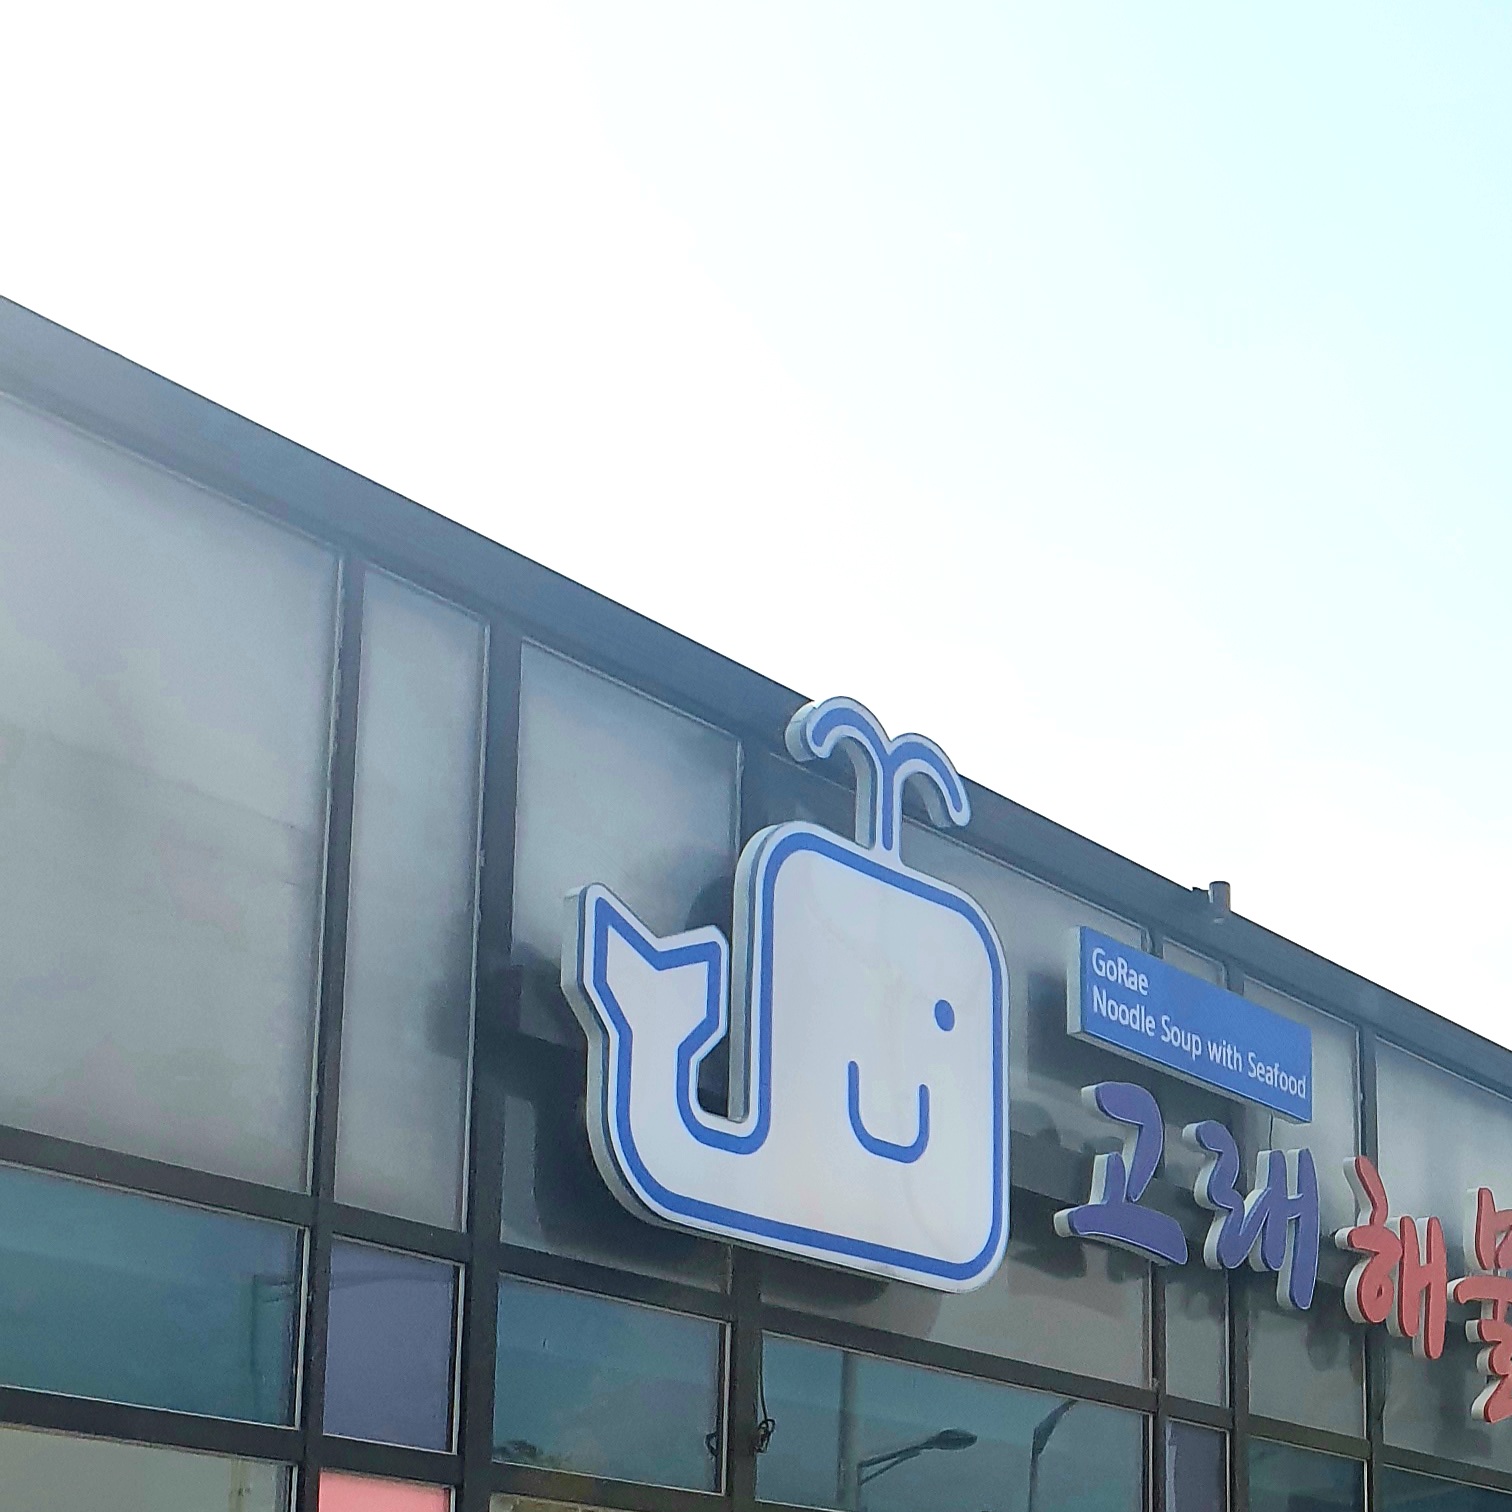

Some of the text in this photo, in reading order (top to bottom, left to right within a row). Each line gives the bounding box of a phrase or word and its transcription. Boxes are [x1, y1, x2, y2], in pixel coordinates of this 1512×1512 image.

[1092, 948, 1148, 995] GoRae
[1093, 984, 1307, 1099] Noodle Soup with Seafood
[1056, 1081, 1320, 1310] 고래
